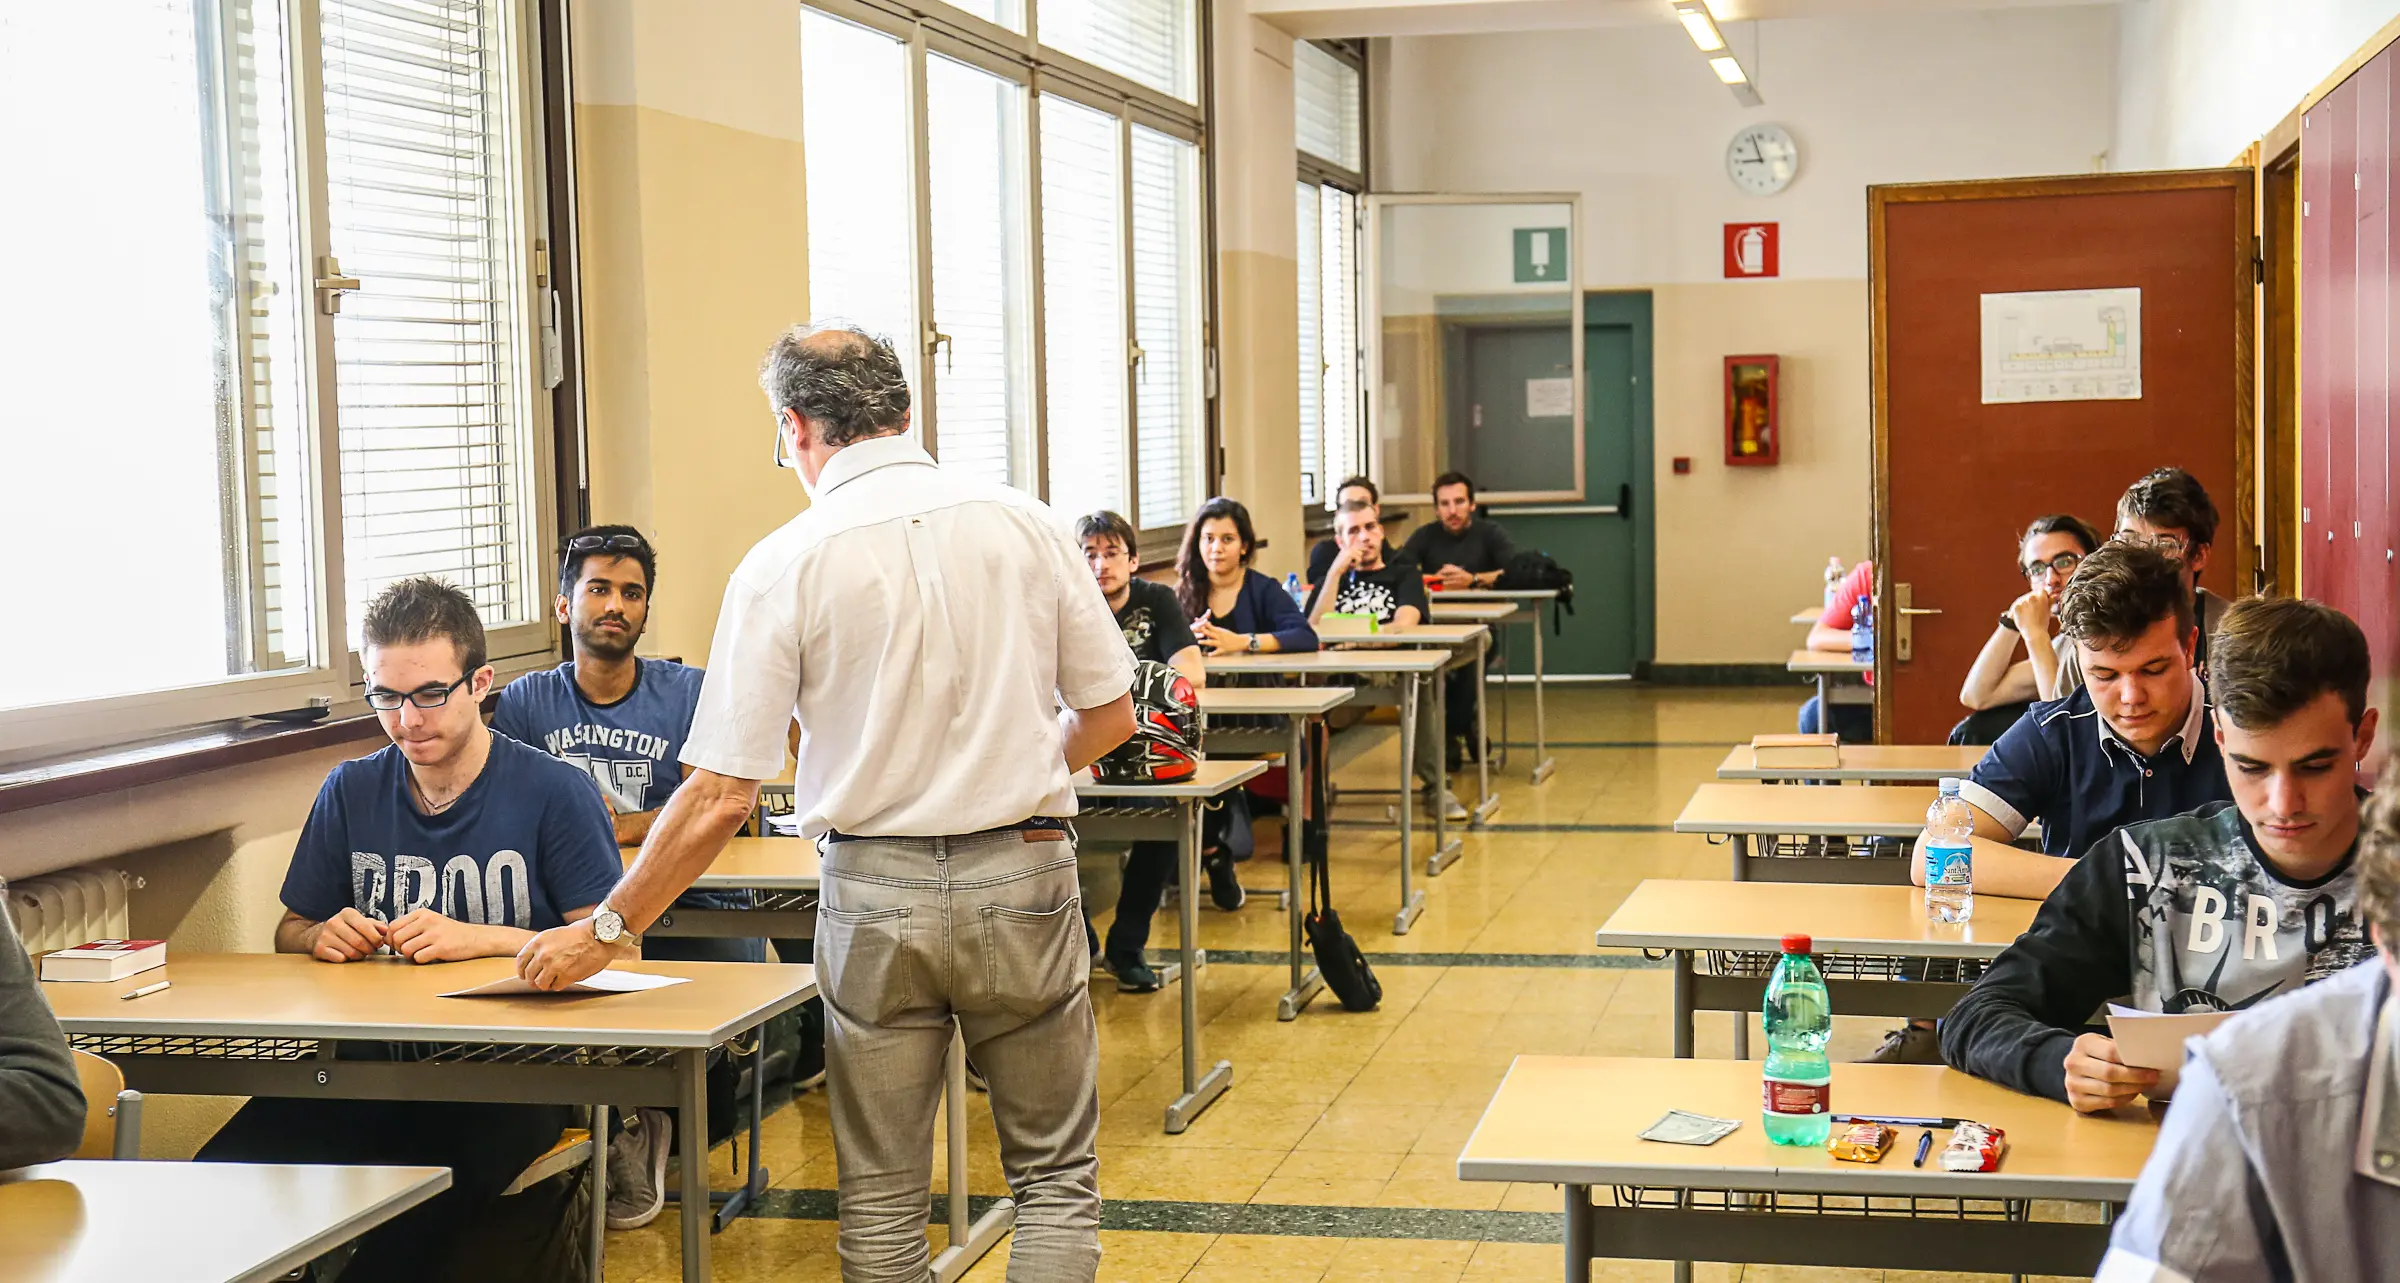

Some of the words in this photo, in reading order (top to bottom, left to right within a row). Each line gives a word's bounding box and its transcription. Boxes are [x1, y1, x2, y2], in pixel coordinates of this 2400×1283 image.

[626, 766, 646, 778] D.C.
[2187, 886, 2371, 961] BRO
[317, 1071, 327, 1084] 6
